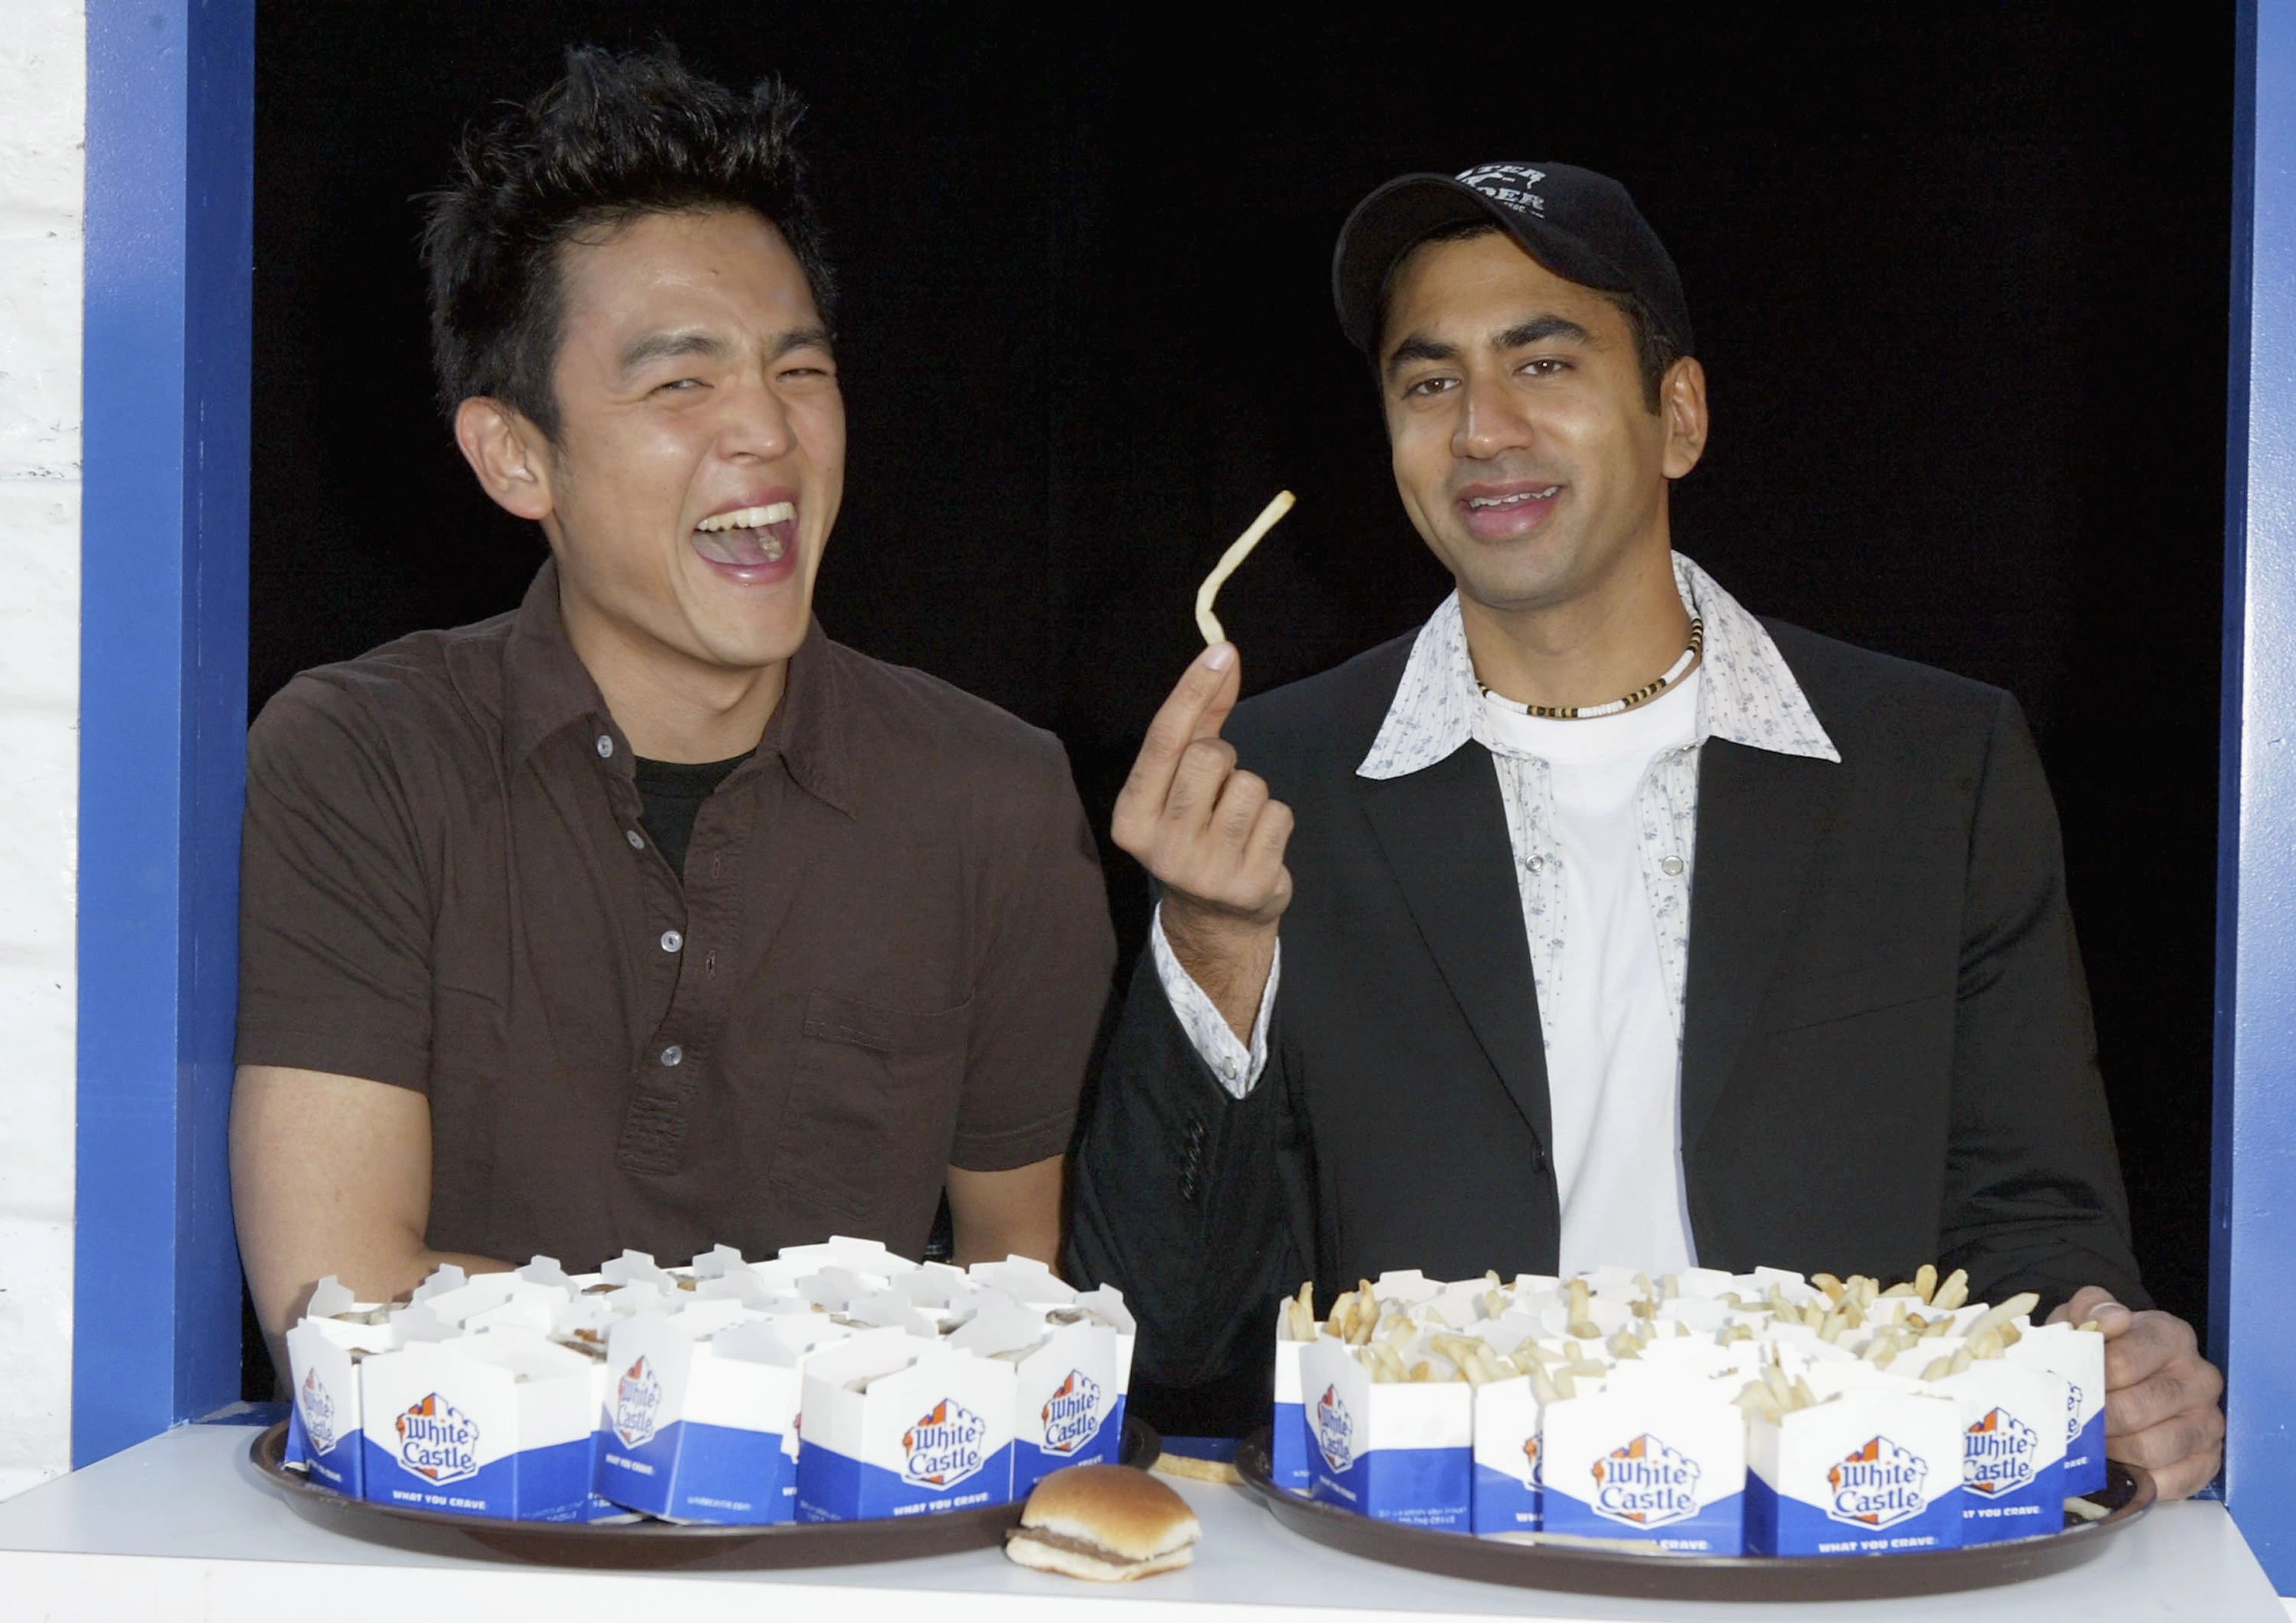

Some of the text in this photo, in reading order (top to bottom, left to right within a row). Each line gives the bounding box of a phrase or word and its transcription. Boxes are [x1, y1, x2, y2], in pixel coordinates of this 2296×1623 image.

[617, 1404, 652, 1432] Castle
[1051, 1393, 1094, 1422] White
[406, 1417, 468, 1447] White
[915, 1423, 975, 1451] White
[1046, 1413, 1095, 1445] Castle
[403, 1442, 472, 1469] Castle
[1965, 1433, 2027, 1460] White
[909, 1447, 978, 1475] Castle
[1608, 1461, 1687, 1487] White
[2064, 1456, 2087, 1469] RAVE
[1842, 1463, 1916, 1490] White
[393, 1490, 486, 1510] WHAT YOU CRAVE
[893, 1492, 988, 1516] WHAT YOU CRAVE
[1601, 1487, 1690, 1509] Castle
[1836, 1487, 1919, 1512] Castle
[1978, 1508, 2001, 1518] YOU
[2004, 1506, 2039, 1517] CRAVE
[1819, 1536, 1935, 1552] WHAT YOU CRAVE
